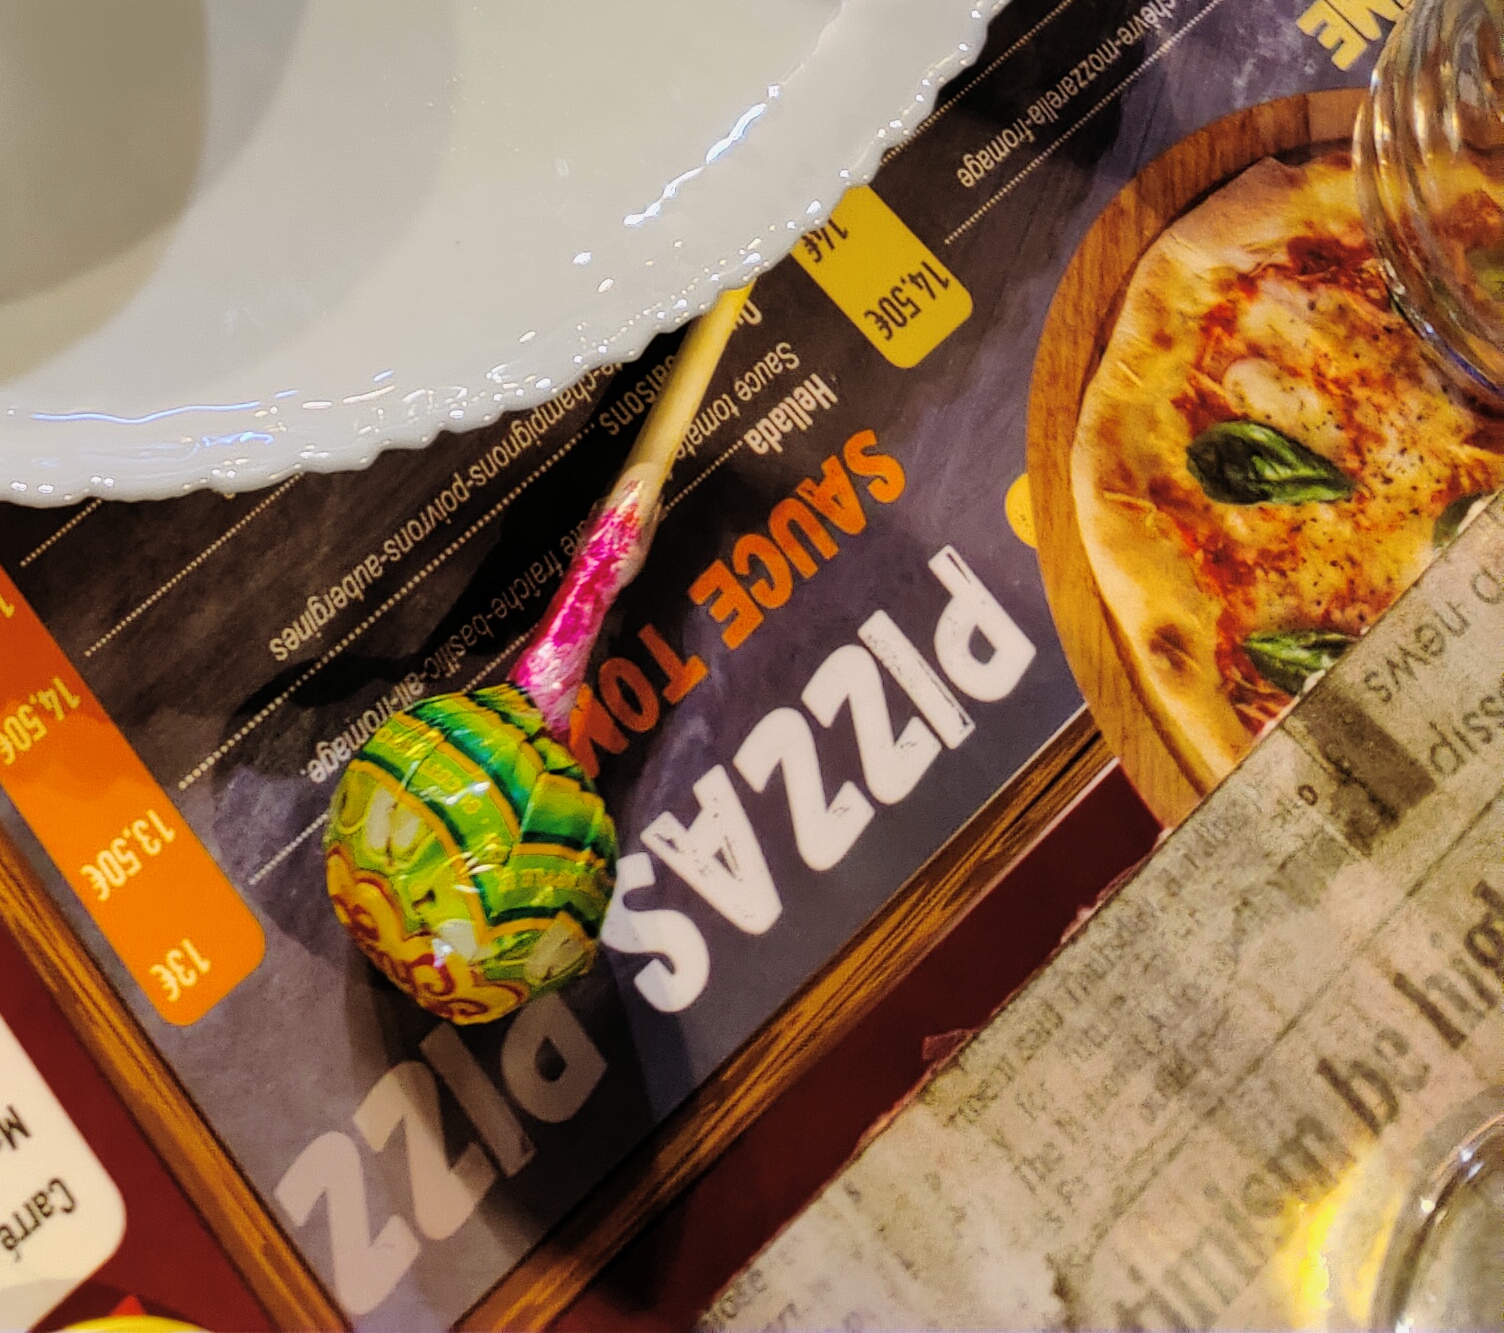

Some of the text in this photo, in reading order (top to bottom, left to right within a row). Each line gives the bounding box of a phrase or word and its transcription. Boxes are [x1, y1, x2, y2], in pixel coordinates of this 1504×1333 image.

[864, 261, 949, 340] 14,50€
[734, 342, 800, 402] Sauce
[745, 374, 837, 455] Hellada
[570, 433, 912, 776] SAUCE TOM
[604, 542, 1037, 1013] PIZZAS
[81, 811, 174, 900] 13,50€
[148, 936, 212, 1003] 13€
